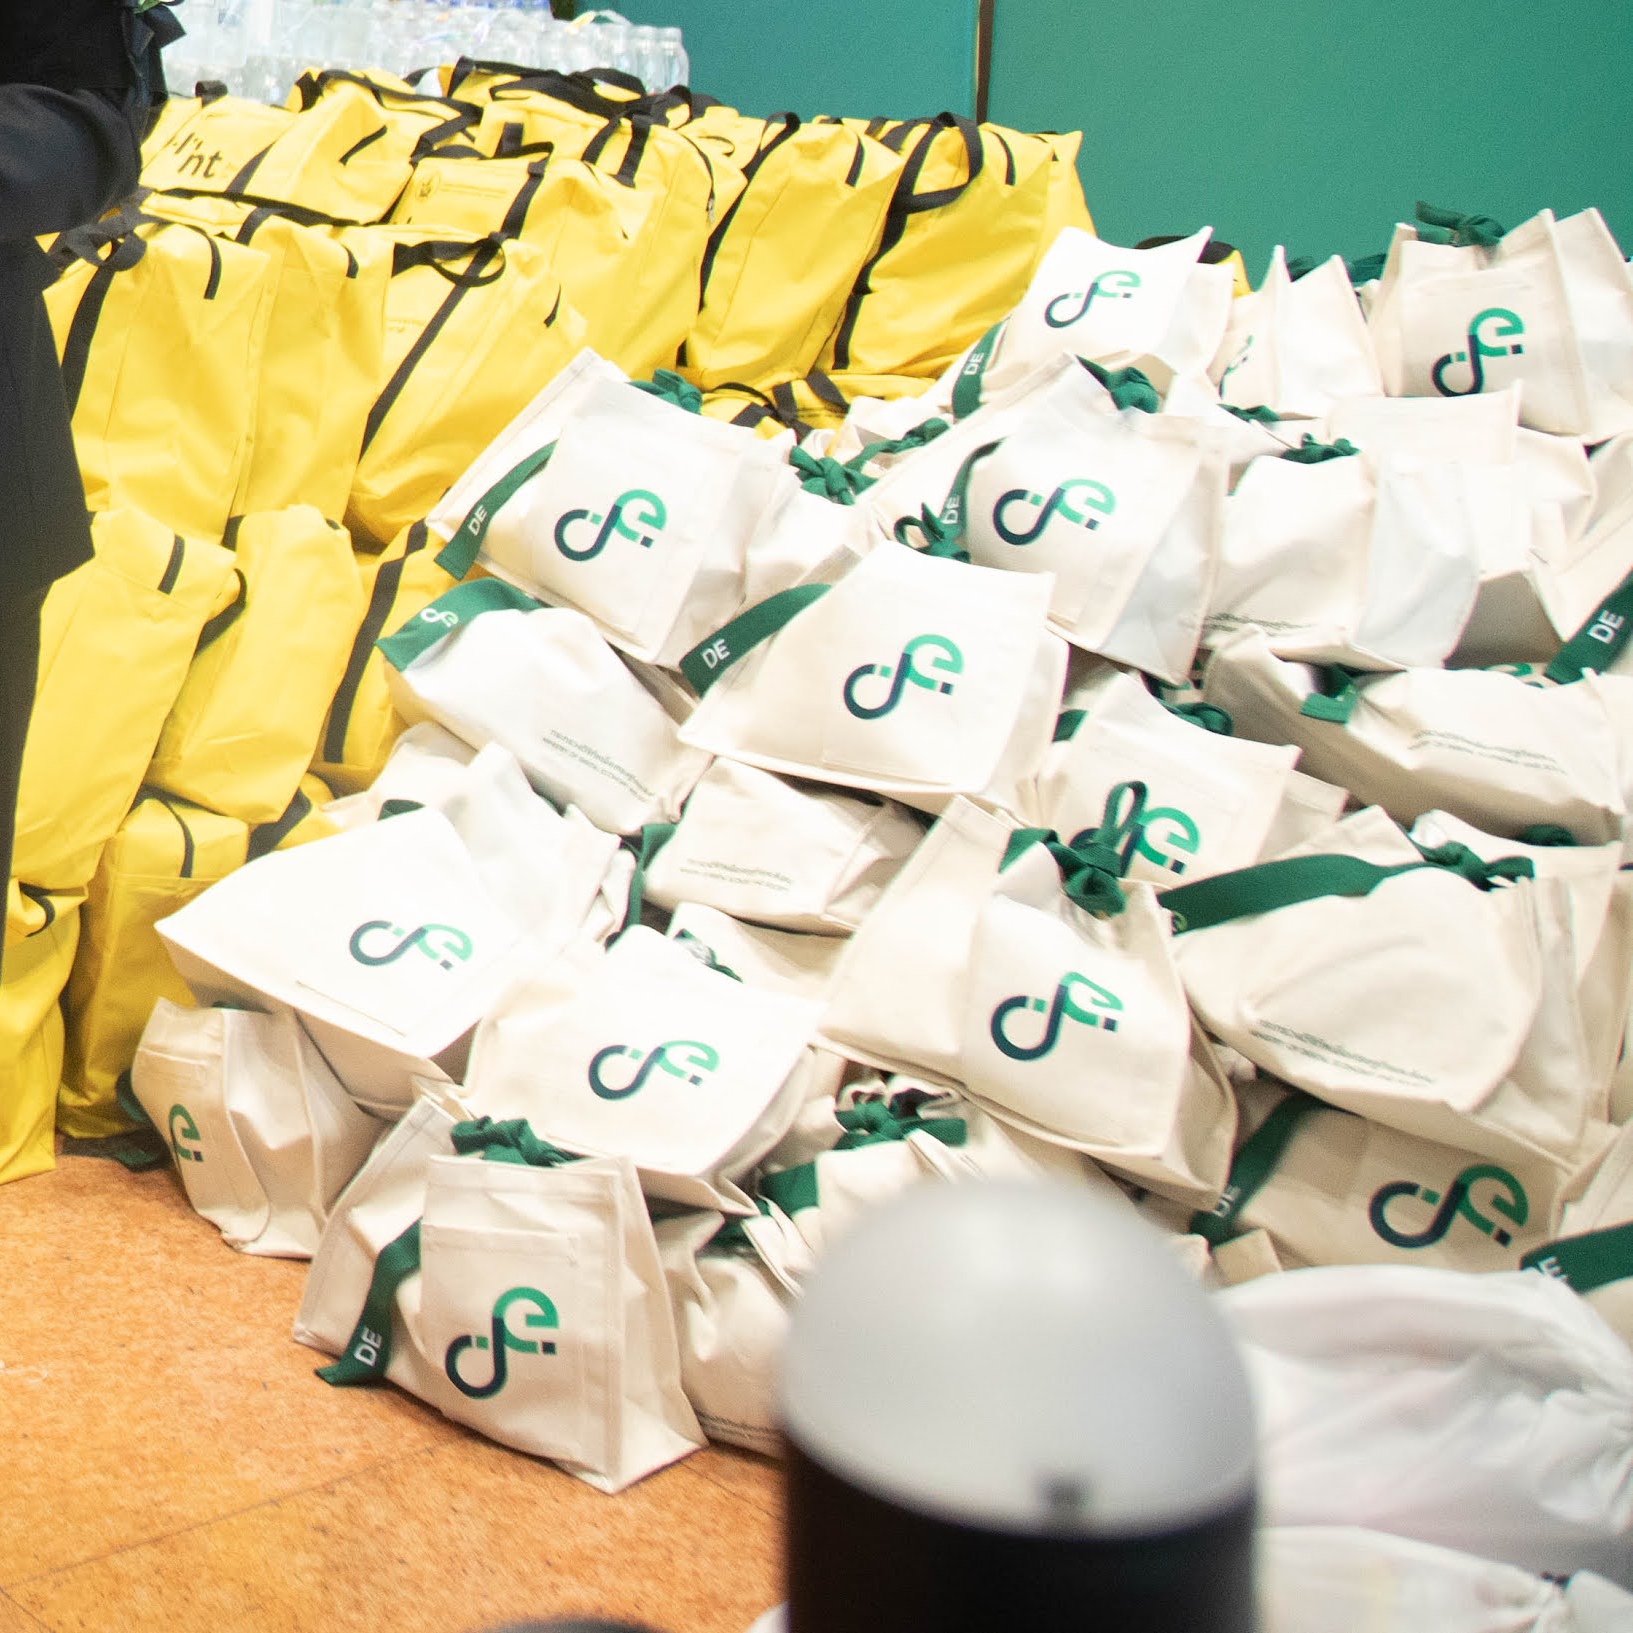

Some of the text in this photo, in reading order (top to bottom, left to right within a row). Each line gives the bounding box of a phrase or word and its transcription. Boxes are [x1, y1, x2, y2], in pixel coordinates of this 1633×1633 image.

[468, 505, 487, 536] DE
[1587, 609, 1624, 644] DE
[701, 639, 730, 669] DE
[354, 1327, 382, 1366] DE
